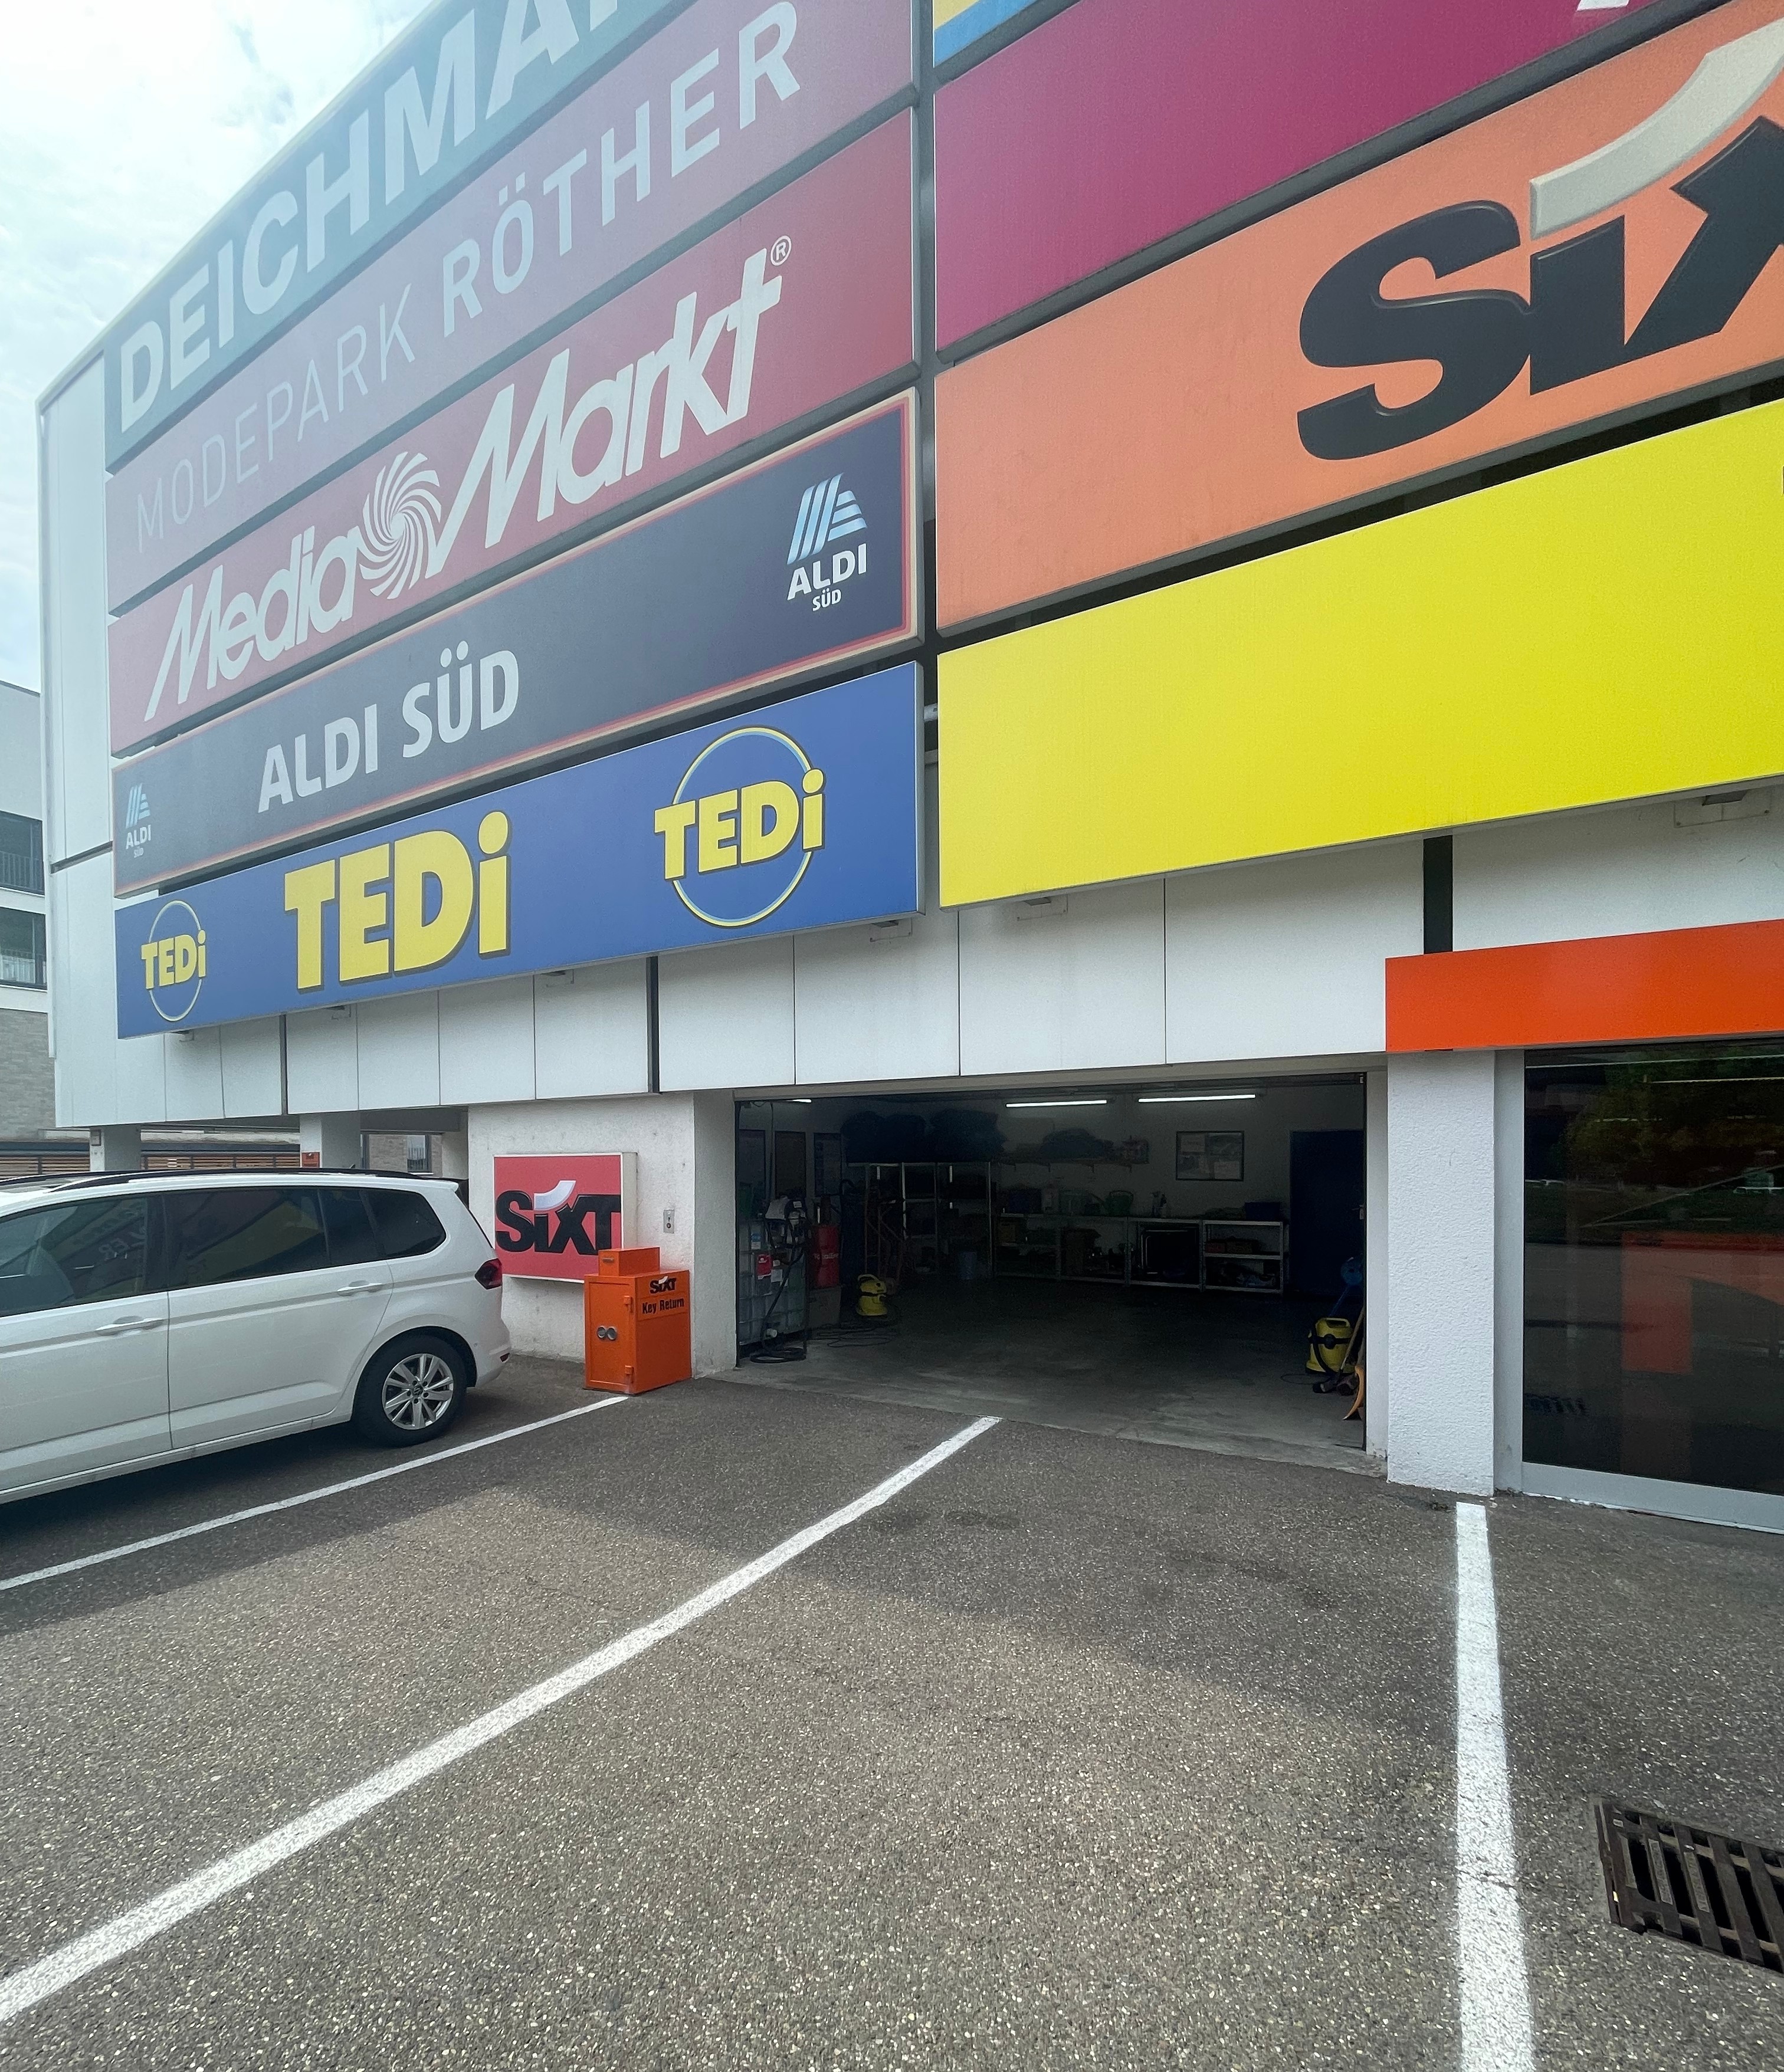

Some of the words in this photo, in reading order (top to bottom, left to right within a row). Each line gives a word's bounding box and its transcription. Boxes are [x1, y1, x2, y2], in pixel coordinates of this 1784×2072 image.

[120, 0, 617, 434] DEICHMA
[137, 285, 415, 553] MODEPARK
[443, 1, 800, 337] RÖTHER
[787, 543, 867, 600] ALDI
[812, 587, 842, 611] SÜD
[258, 704, 378, 813] ALDI
[402, 641, 519, 758] SÜD
[126, 825, 151, 849] ALDI
[654, 768, 825, 879] TEDi
[284, 811, 510, 991] TEDi
[141, 929, 208, 990] TEDi
[642, 1302, 657, 1314] Key
[660, 1298, 684, 1311] Return
